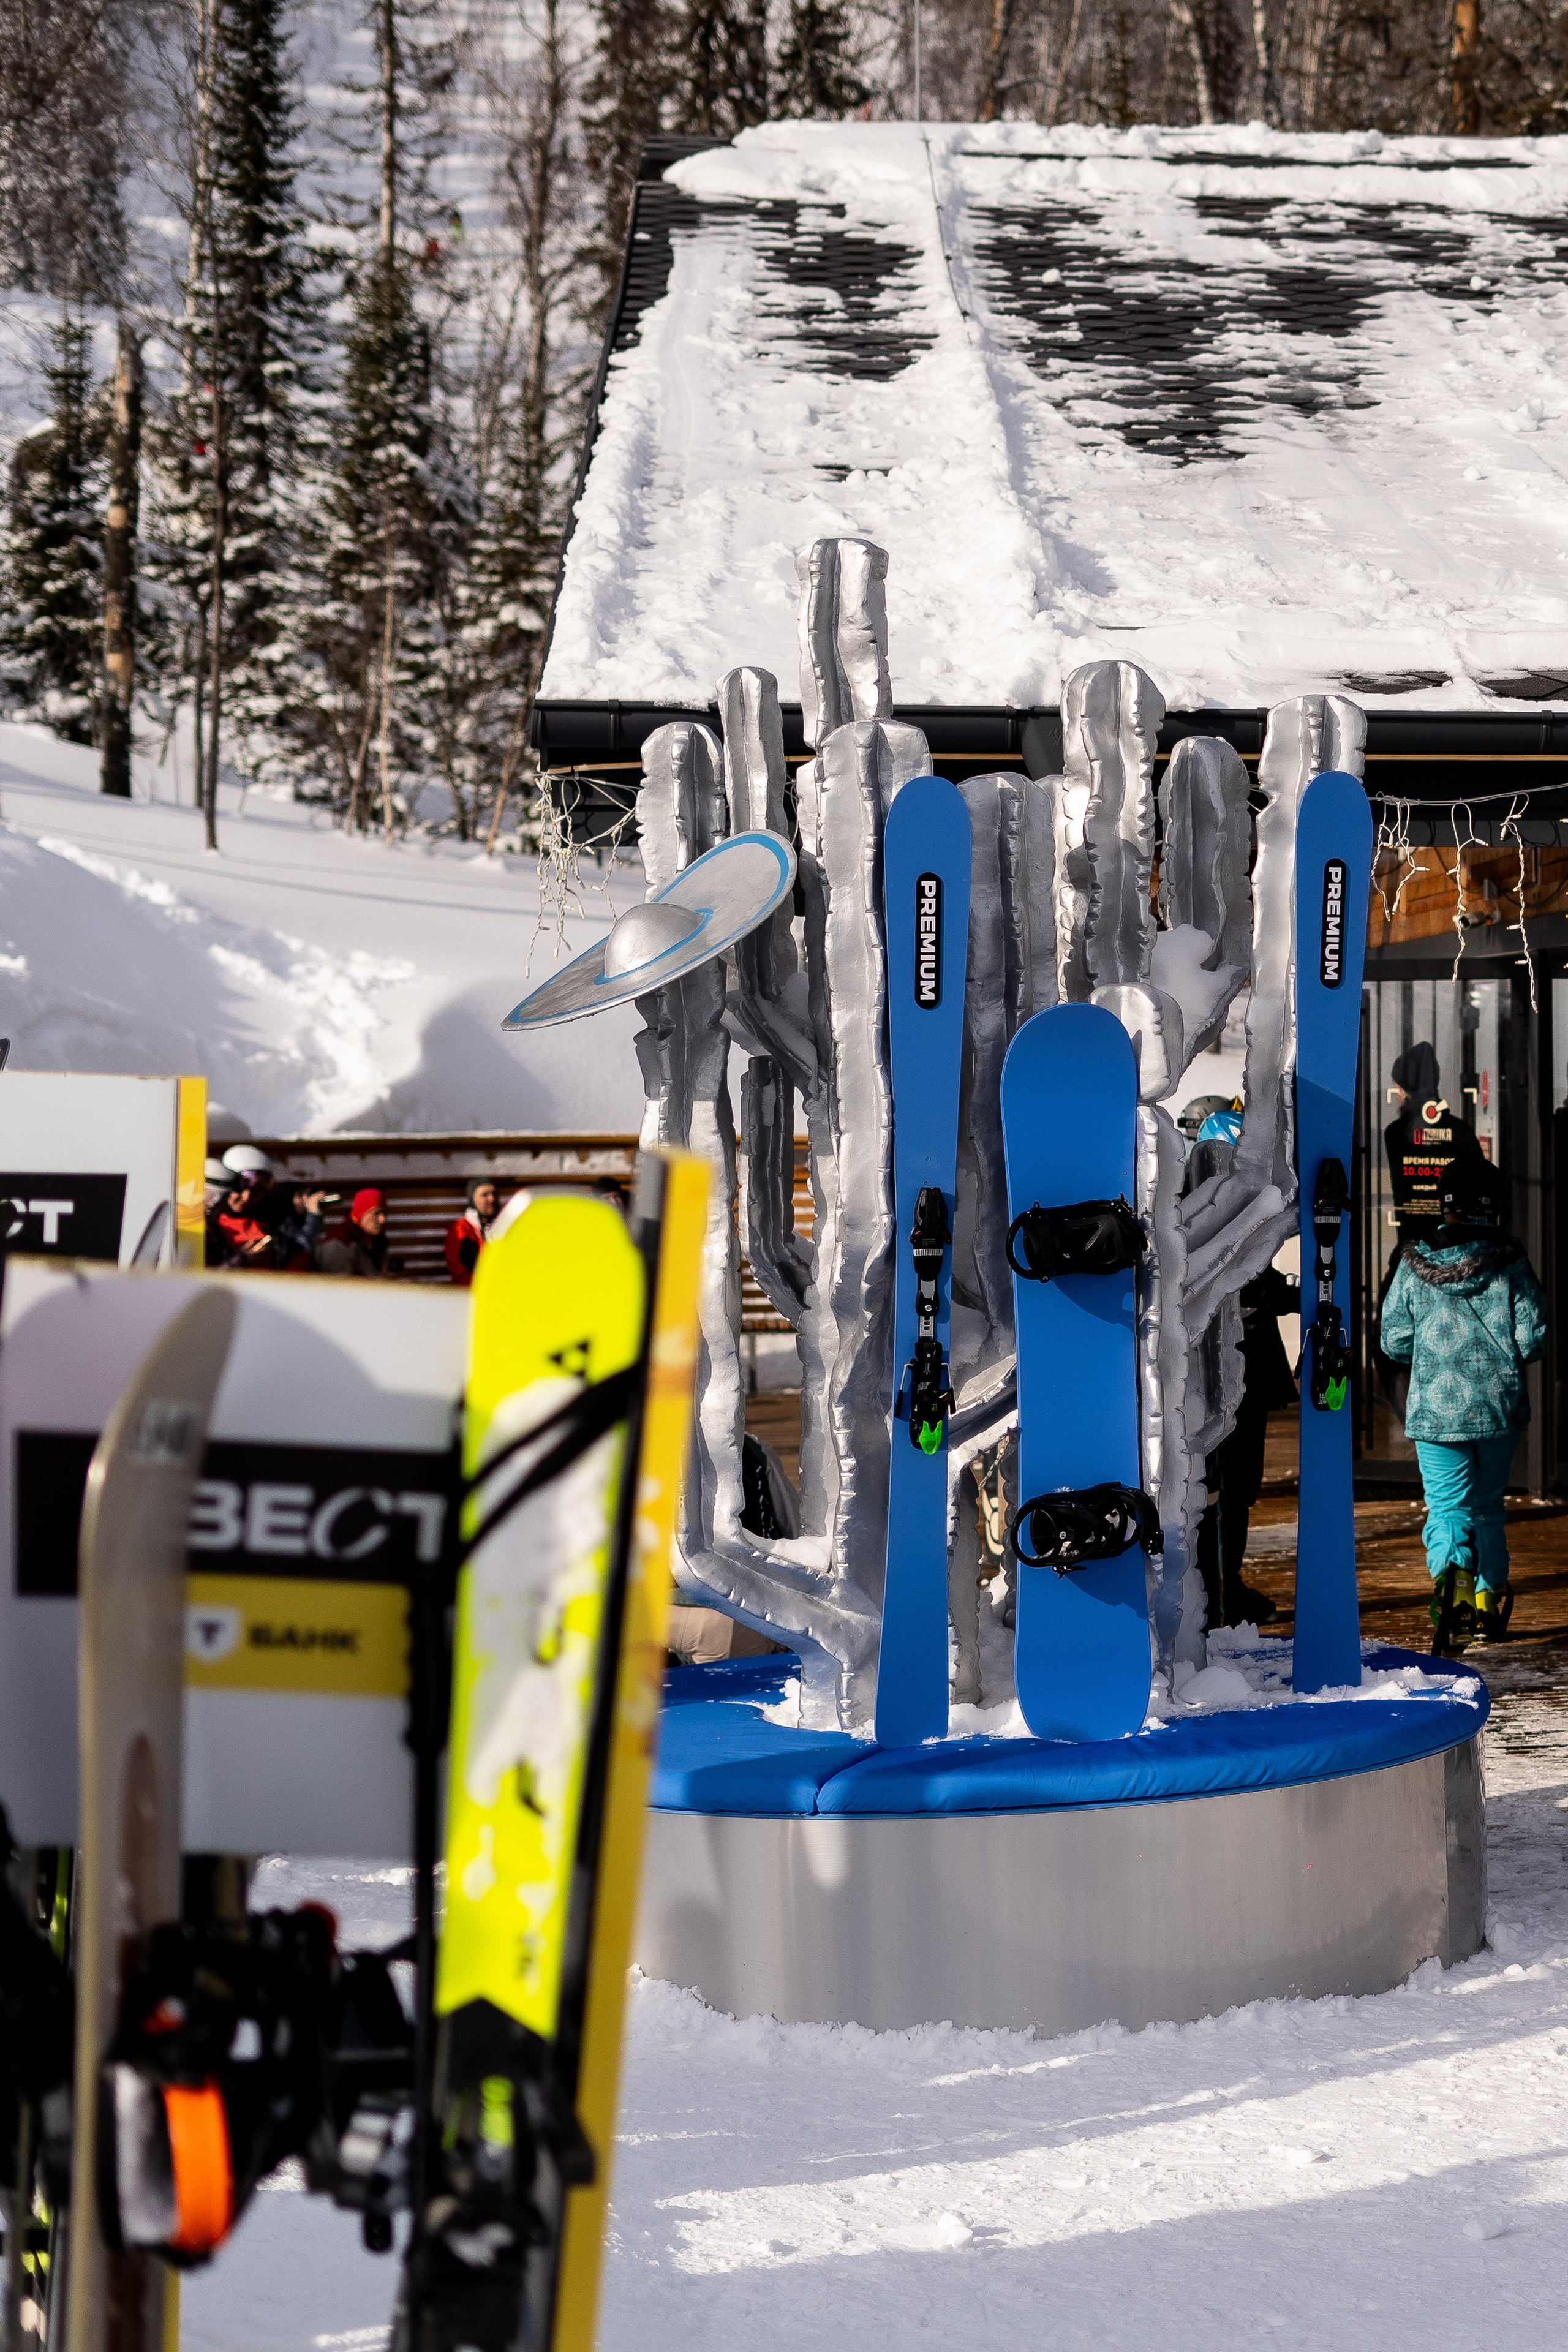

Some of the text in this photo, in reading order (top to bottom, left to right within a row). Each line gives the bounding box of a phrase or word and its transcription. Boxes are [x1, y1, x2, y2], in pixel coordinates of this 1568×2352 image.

[920, 881, 937, 1000] PREMIUM
[1324, 867, 1342, 980] PREMIUM
[1403, 1156, 1429, 1165] ВРЕМЯ
[1403, 1166, 1443, 1176] 10.00-2
